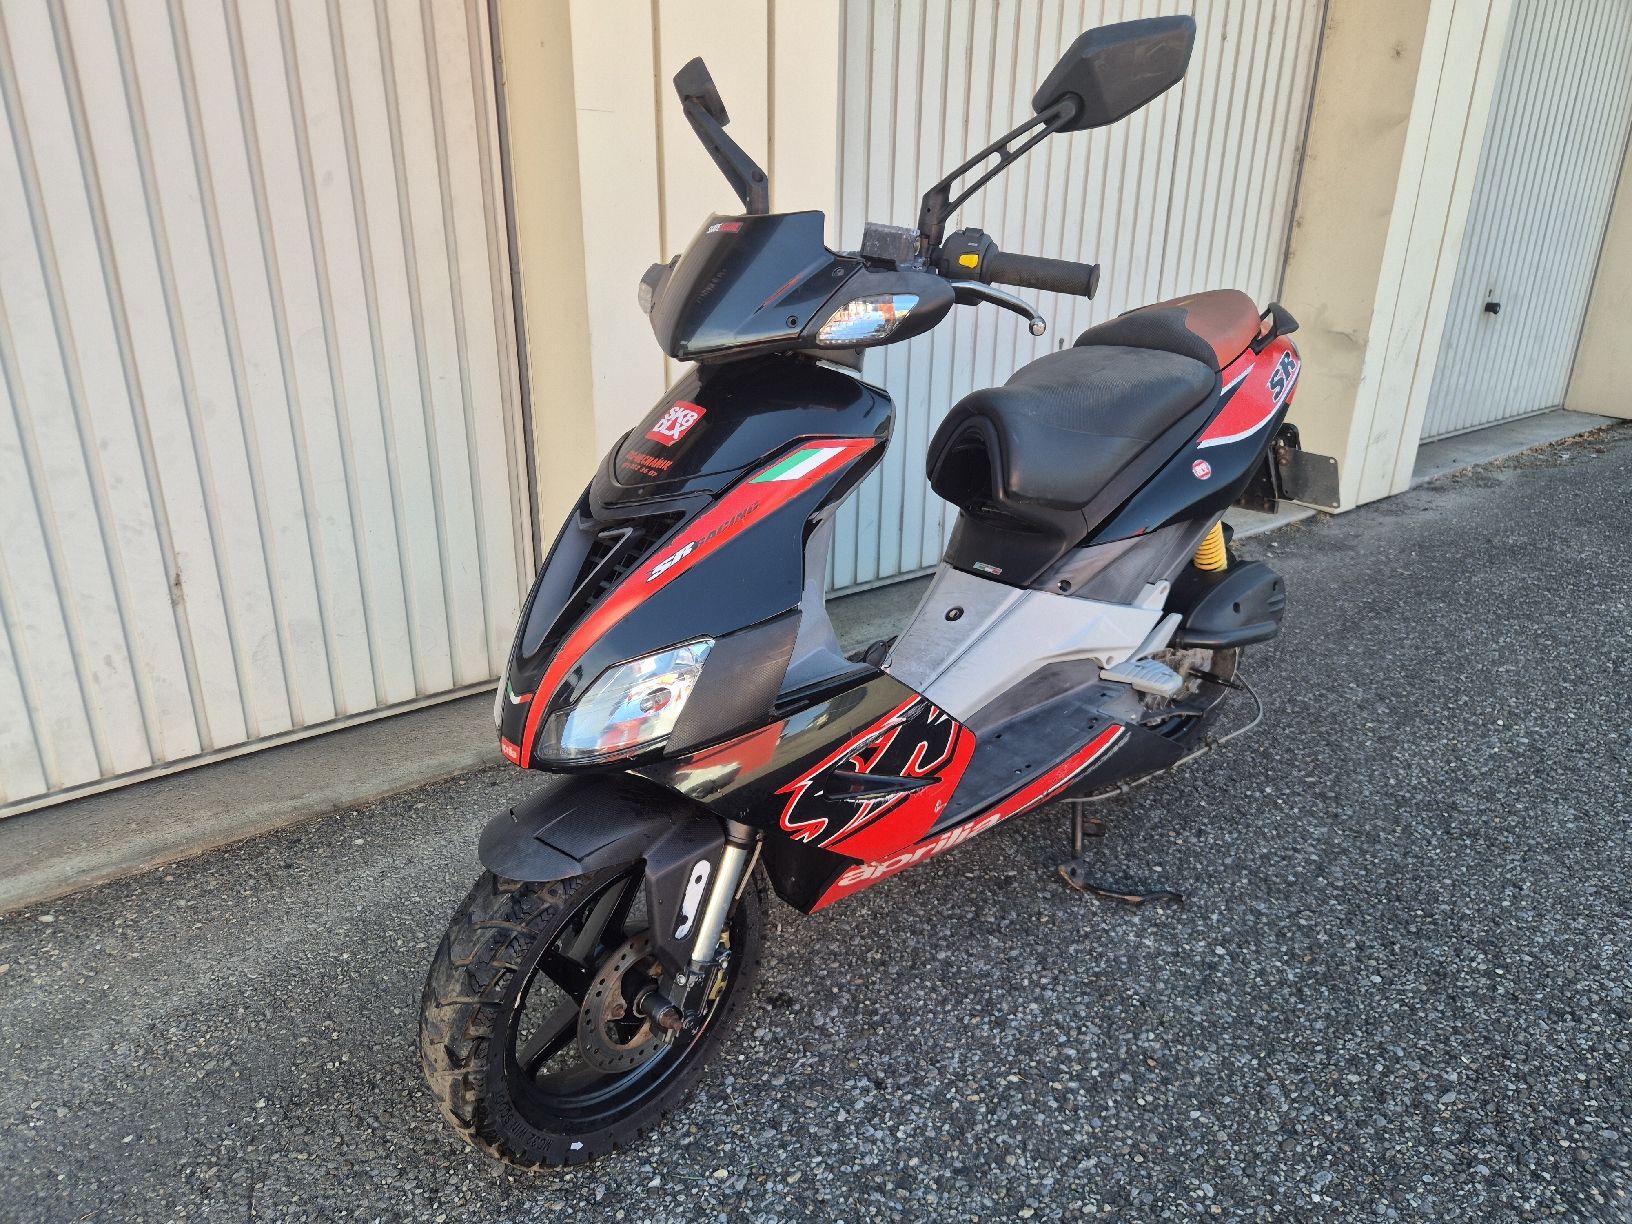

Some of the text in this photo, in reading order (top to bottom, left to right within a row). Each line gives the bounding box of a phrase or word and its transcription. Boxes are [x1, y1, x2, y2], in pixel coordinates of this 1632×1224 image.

[1267, 350, 1296, 402] SR
[669, 406, 698, 427] SK8
[645, 541, 697, 583] SR
[778, 697, 957, 848] SR
[837, 812, 1001, 887] aprilia
